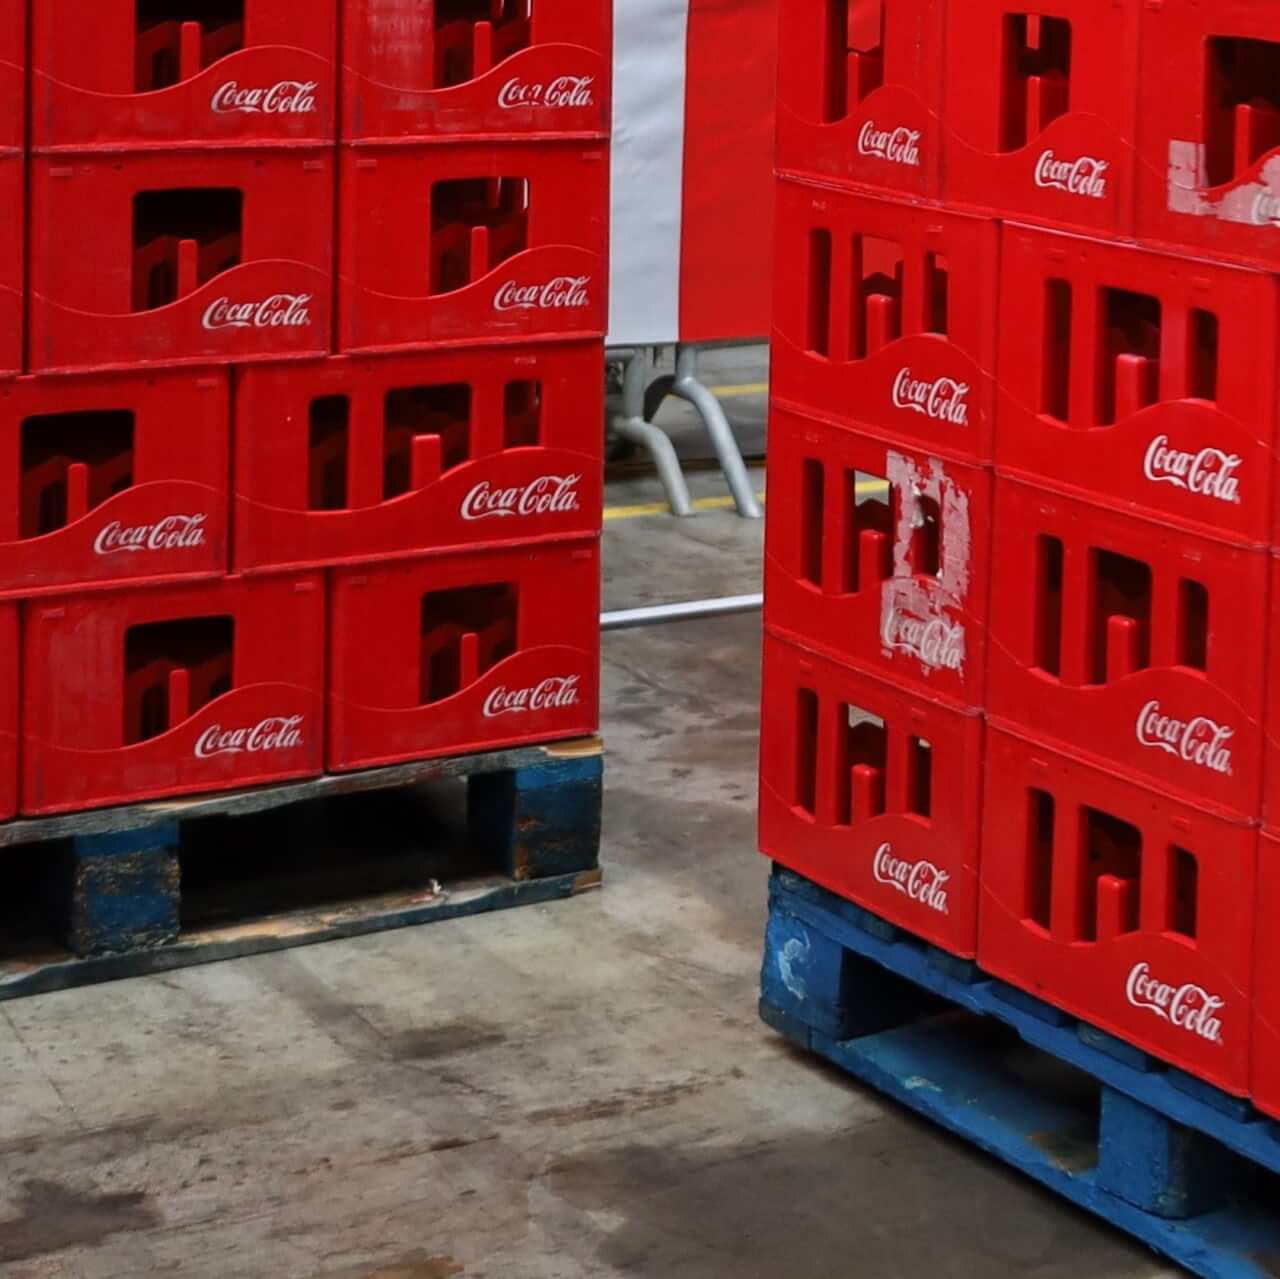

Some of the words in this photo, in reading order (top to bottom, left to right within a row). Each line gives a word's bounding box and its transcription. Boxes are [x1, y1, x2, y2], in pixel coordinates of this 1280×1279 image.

[211, 80, 317, 113] Coca-Cola
[857, 120, 921, 165] Coca-Cola
[1034, 149, 1108, 198] Coca-Cola
[202, 293, 311, 330] Coca-Cola
[493, 276, 590, 311] Coca-Cola
[892, 367, 969, 425] Coca-Cola
[1143, 435, 1242, 503] Coca-Cola
[460, 473, 581, 521] Coca-Cola
[93, 513, 207, 555] Coca-Cola
[482, 674, 579, 718] Coca-Cola
[194, 714, 303, 759] Coca-Cola
[1136, 700, 1233, 775] Coca-Cola
[873, 842, 950, 914] Coca-Cola
[1125, 962, 1225, 1041] Coca-Cola
